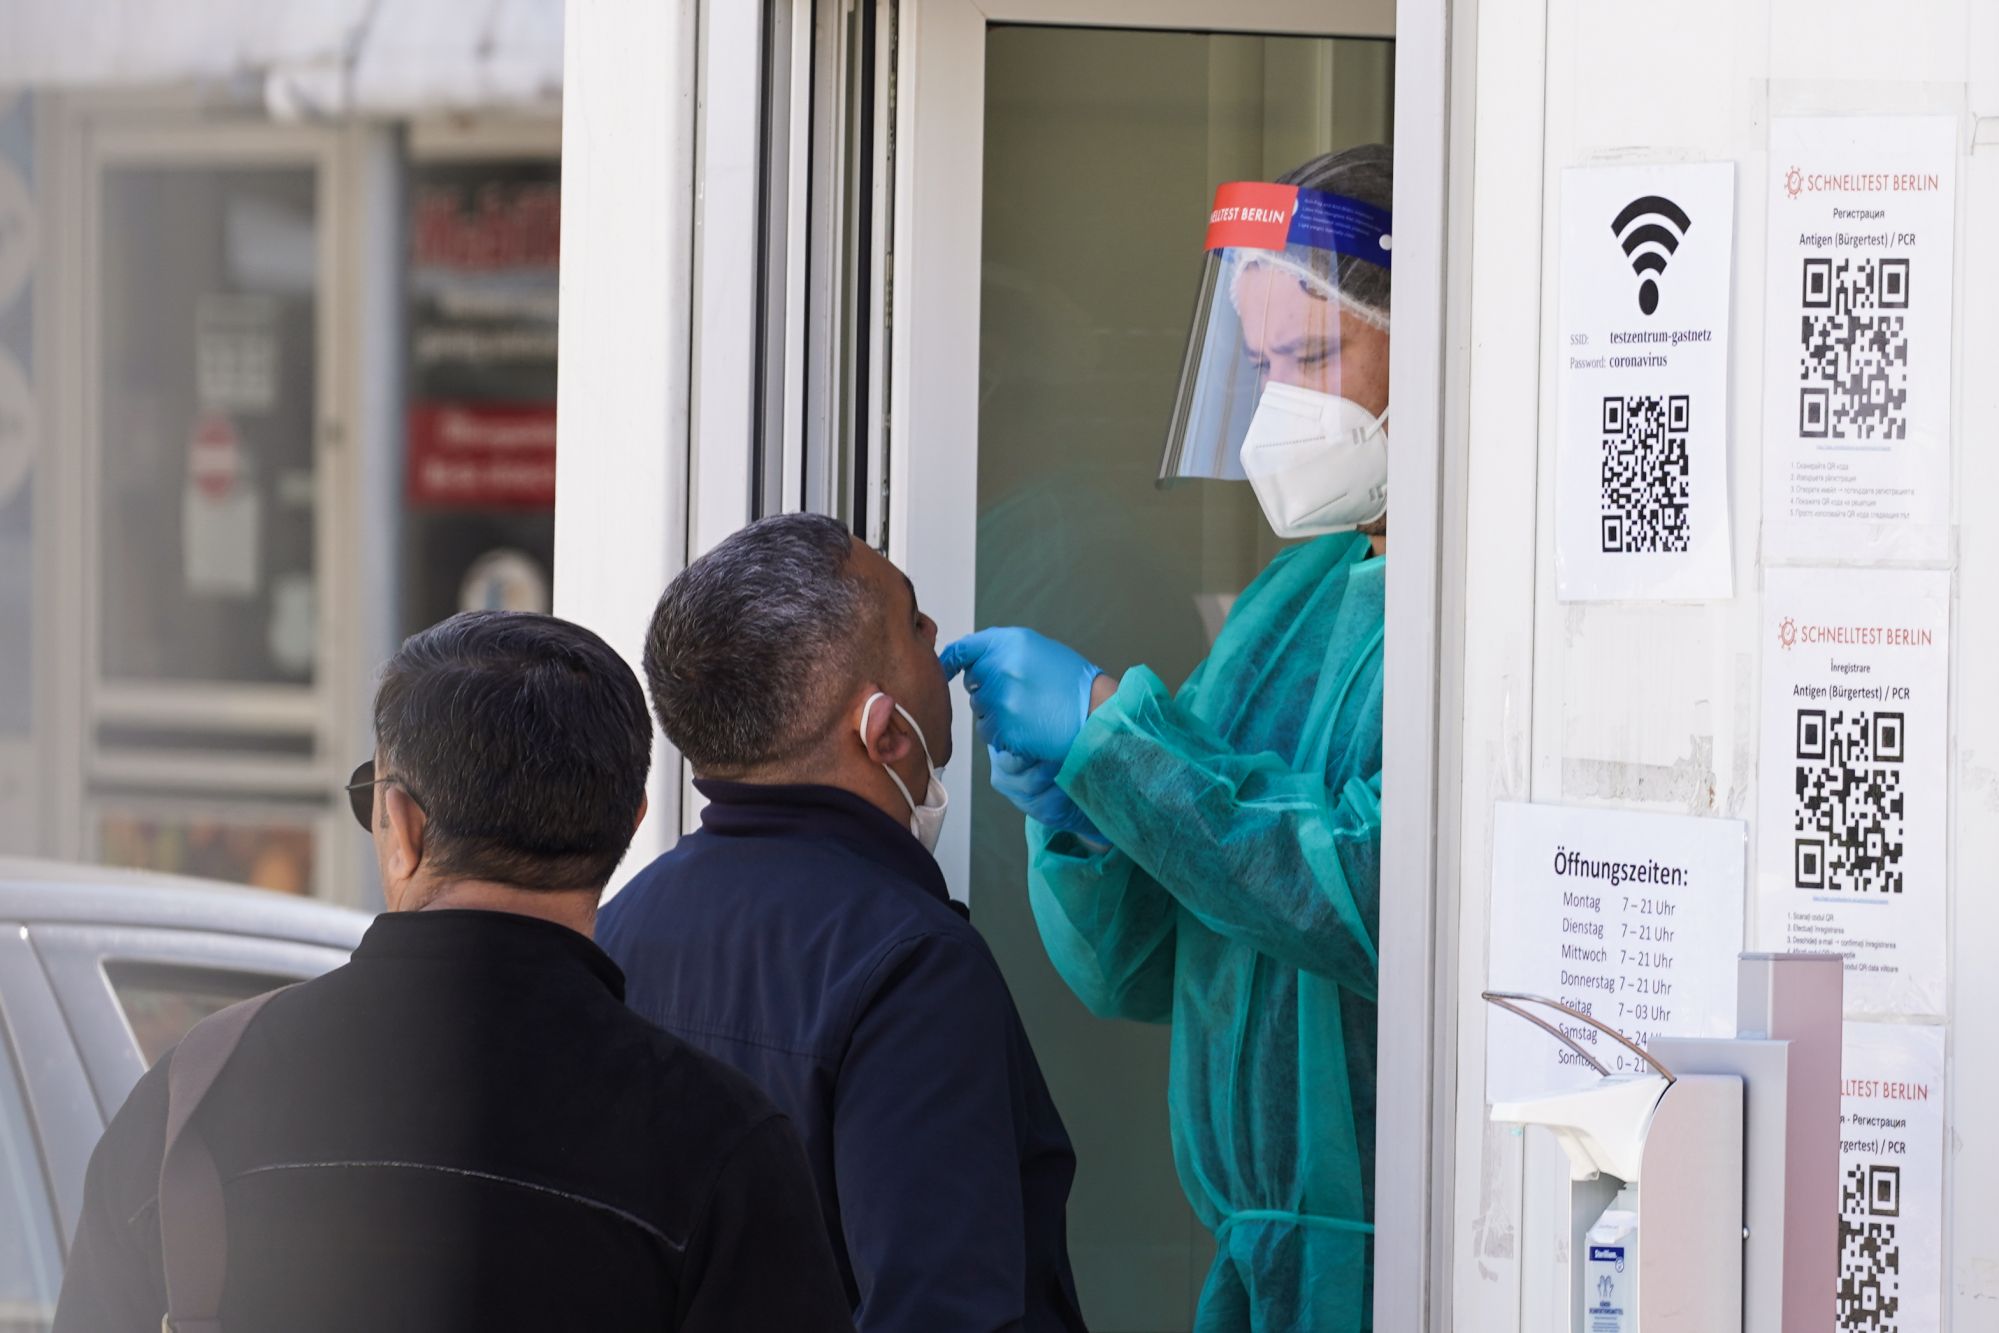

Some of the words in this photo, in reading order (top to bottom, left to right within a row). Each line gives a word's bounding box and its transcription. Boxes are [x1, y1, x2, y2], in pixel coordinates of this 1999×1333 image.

[1807, 174, 1890, 192] SCHNELLTEST
[1893, 174, 1939, 192] BERLIN
[1241, 207, 1285, 224] BERLIN
[1833, 208, 1885, 221] Регистрация
[1799, 232, 1833, 249] Antigen
[1835, 232, 1888, 249] (Bürgertest)
[1890, 232, 1896, 248] /
[1898, 233, 1916, 246] PCR
[1570, 334, 1590, 345] SSID:
[1610, 329, 1713, 347] testzentrum-gastnetz
[1570, 355, 1606, 369] Password:
[1609, 352, 1668, 369] coronavirus
[1801, 626, 1883, 645] SCHNELLTEST
[1887, 629, 1932, 646] BERLIN
[1793, 684, 1827, 700] Antigen
[1829, 684, 1882, 702] (Bürgertest)
[1885, 685, 1890, 702] /
[1892, 687, 1910, 700] PCR
[1554, 846, 1688, 887] Öffnungszeiten:
[1563, 892, 1601, 913] Montag
[1623, 897, 1629, 912] 7
[1640, 899, 1651, 914] 21
[1656, 900, 1676, 916] Uhr
[1562, 917, 1604, 940] Dienstag
[1621, 923, 1627, 938] 7
[1639, 925, 1651, 941] 21
[1654, 927, 1675, 943] Uhr
[1561, 944, 1607, 962] Mittwoch
[1620, 950, 1627, 965] 7
[1638, 952, 1650, 967] 21
[1653, 953, 1673, 969] Uhr
[1561, 970, 1615, 994] Donnerstag
[1619, 976, 1625, 991] 7
[1636, 978, 1649, 994] 21
[1652, 979, 1672, 995] Uhr
[1618, 1002, 1624, 1017] 7
[1635, 1004, 1648, 1020] 03
[1651, 1006, 1671, 1021] Uhr
[1558, 1023, 1598, 1045] Samstag
[1635, 1031, 1647, 1047] 24
[1617, 1055, 1623, 1070] 0
[1634, 1057, 1646, 1073] 21
[1840, 1080, 1879, 1098] LLTEST
[1883, 1082, 1928, 1100] BERLIN
[1852, 1114, 1906, 1129] Регистрация
[1840, 1138, 1879, 1155] rgertest)
[1880, 1138, 1886, 1155] /
[1888, 1141, 1906, 1154] PCR
